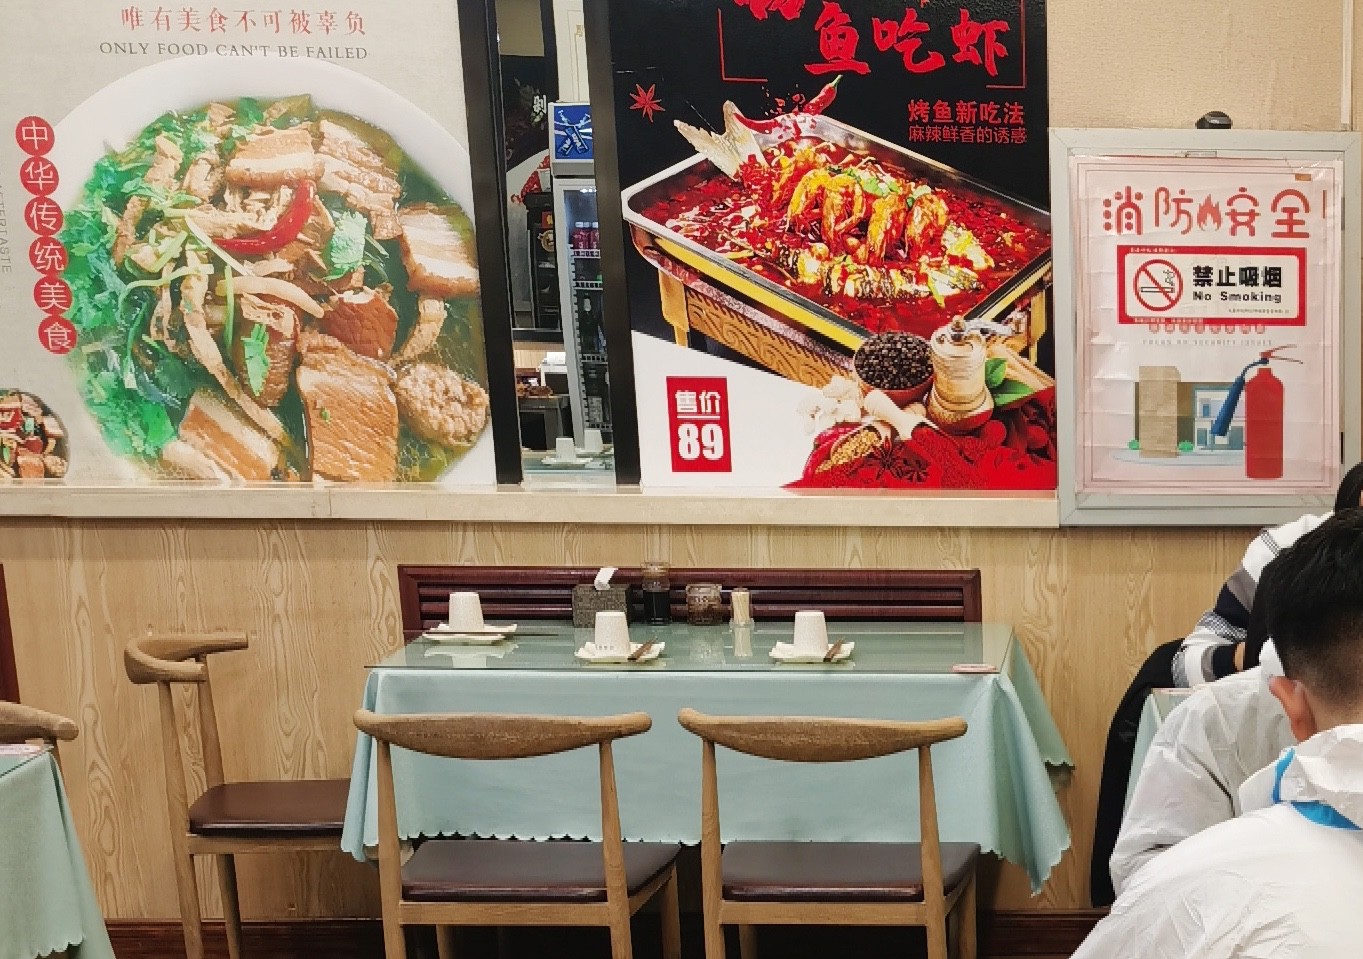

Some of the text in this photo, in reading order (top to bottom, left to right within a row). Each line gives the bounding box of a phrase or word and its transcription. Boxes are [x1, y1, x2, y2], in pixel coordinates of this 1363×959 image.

[121, 6, 367, 36] 唯有美食不可被辜负
[100, 42, 367, 60] ONLY FOOD CAN'T BE FAILED
[908, 99, 1024, 124] 烤鱼新吃法
[908, 124, 1027, 144] 麻辣鲜香的诱惑
[21, 120, 71, 350] 中华传统美食
[1192, 265, 1282, 288] 禁止吸烟
[1193, 291, 1282, 304] No Smoking
[674, 389, 721, 413] 售价
[678, 422, 724, 461] 89
